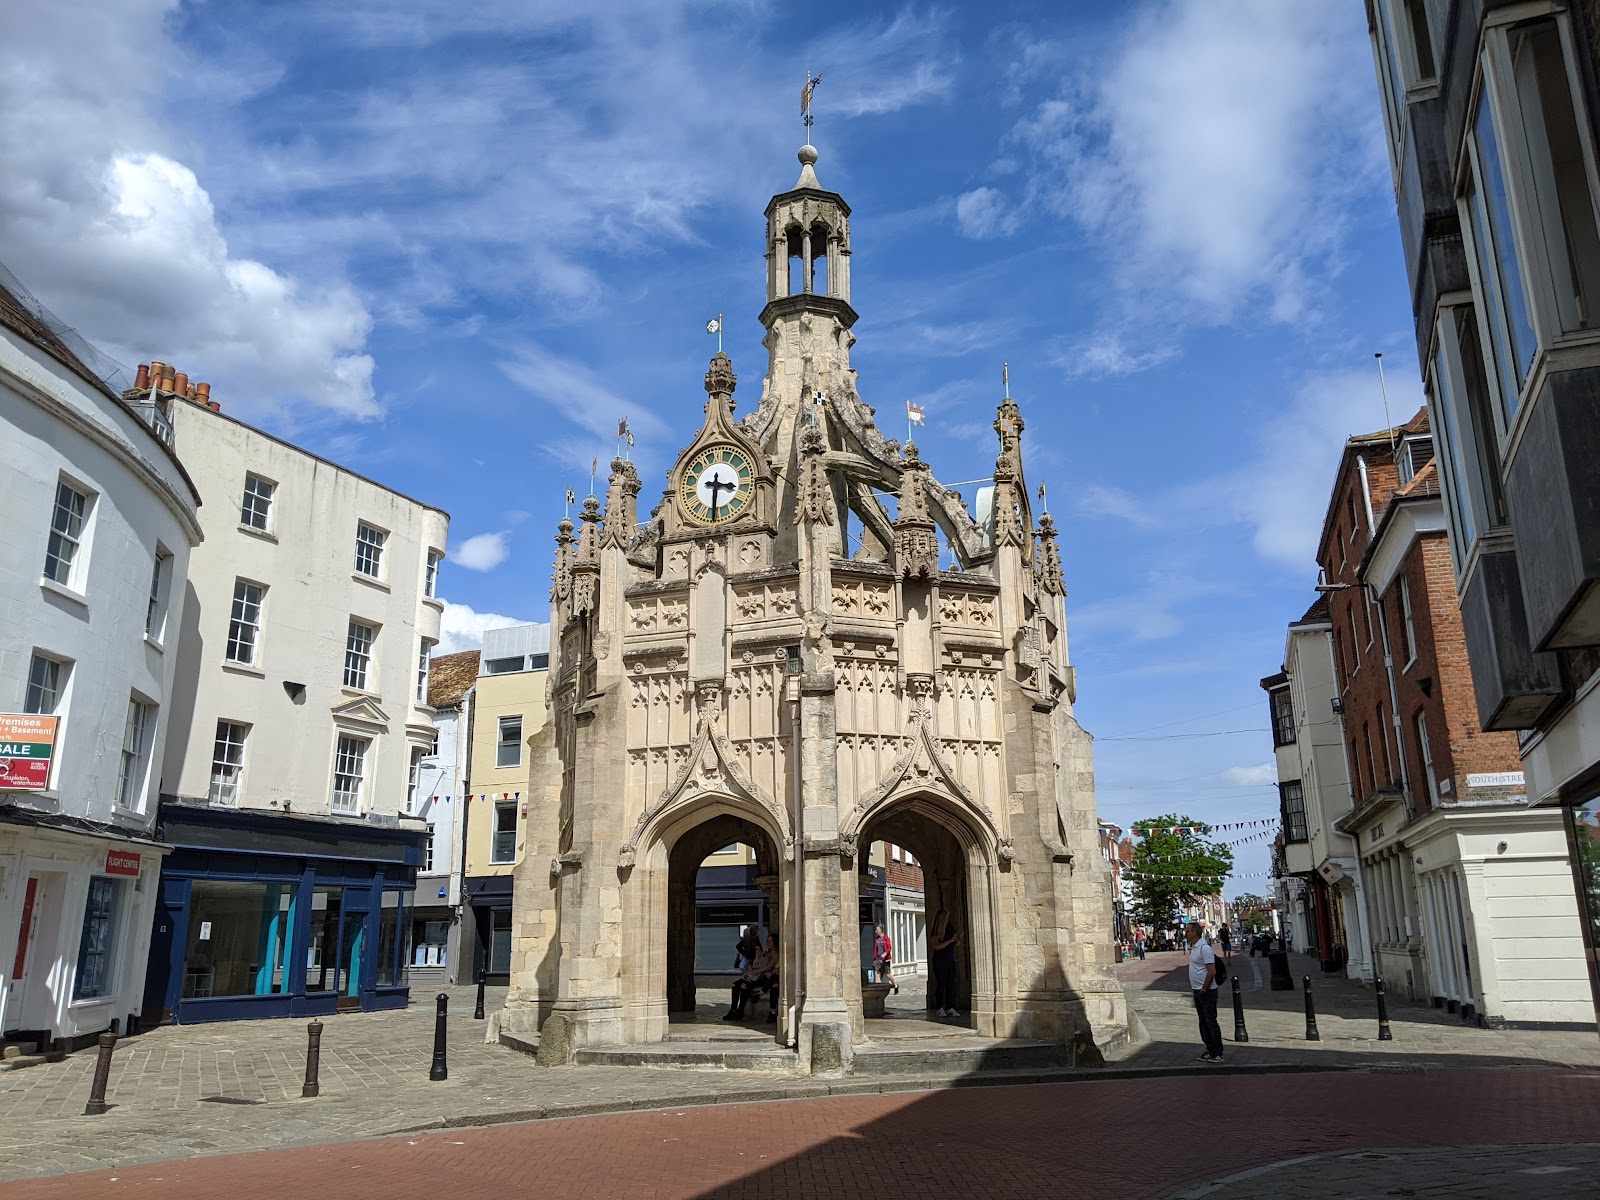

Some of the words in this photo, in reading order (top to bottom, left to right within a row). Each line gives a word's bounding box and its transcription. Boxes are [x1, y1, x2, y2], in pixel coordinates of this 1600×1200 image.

[11, 726, 52, 735] Basement
[3, 774, 29, 783] stapleton
[1470, 775, 1498, 784] SOUTH
[1501, 774, 1524, 782] STRE
[108, 857, 124, 867] FLIGHT
[123, 859, 139, 869] CENTRE
